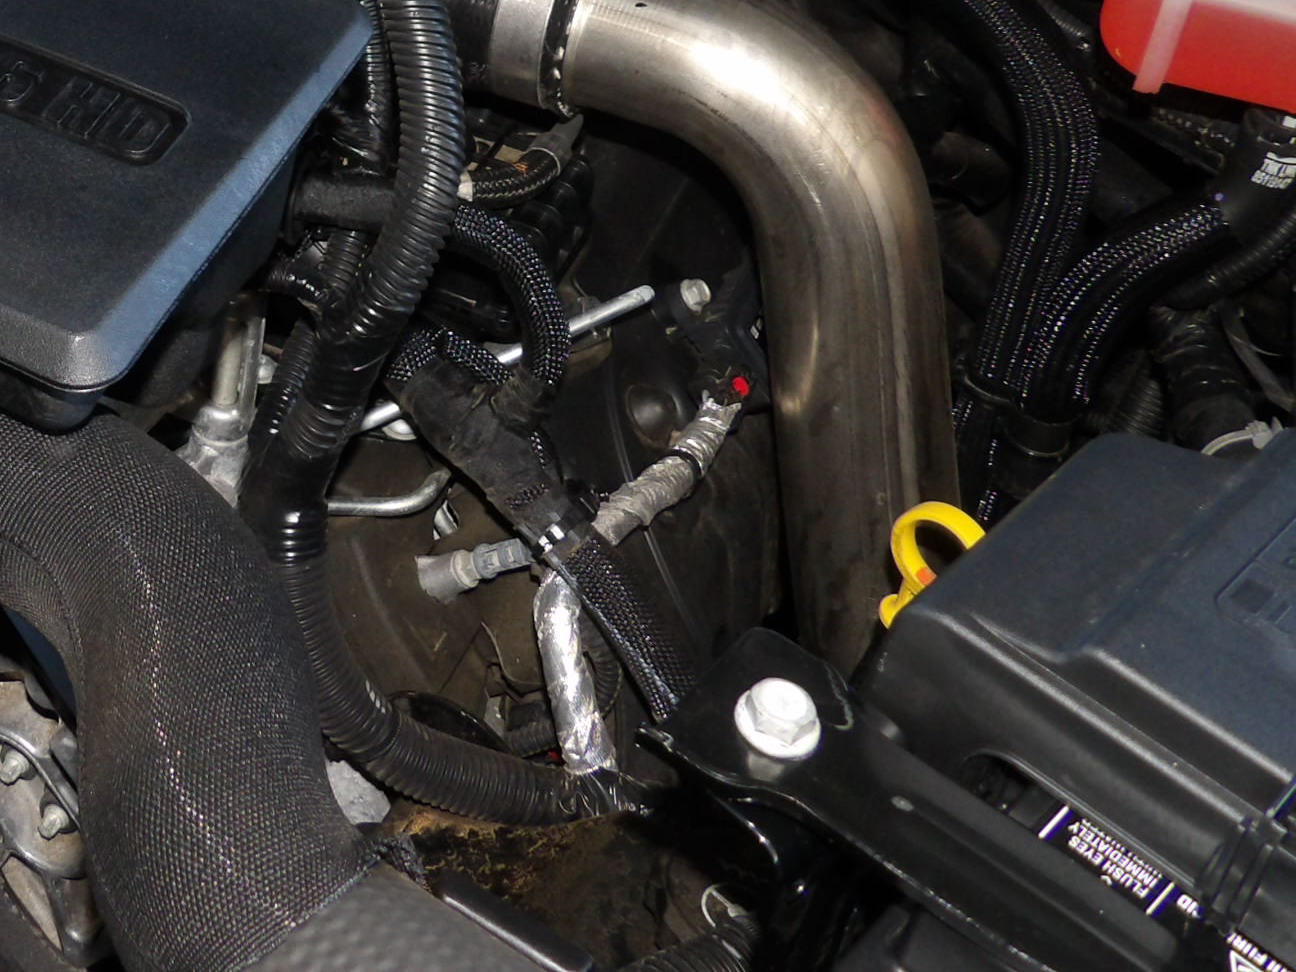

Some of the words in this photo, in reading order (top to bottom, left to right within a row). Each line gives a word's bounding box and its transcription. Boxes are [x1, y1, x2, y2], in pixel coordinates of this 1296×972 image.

[41, 76, 171, 158] HD
[1068, 835, 1104, 865] EYES
[1068, 822, 1160, 888] IMMEDIATELY
[1102, 864, 1149, 900] FLUSH
